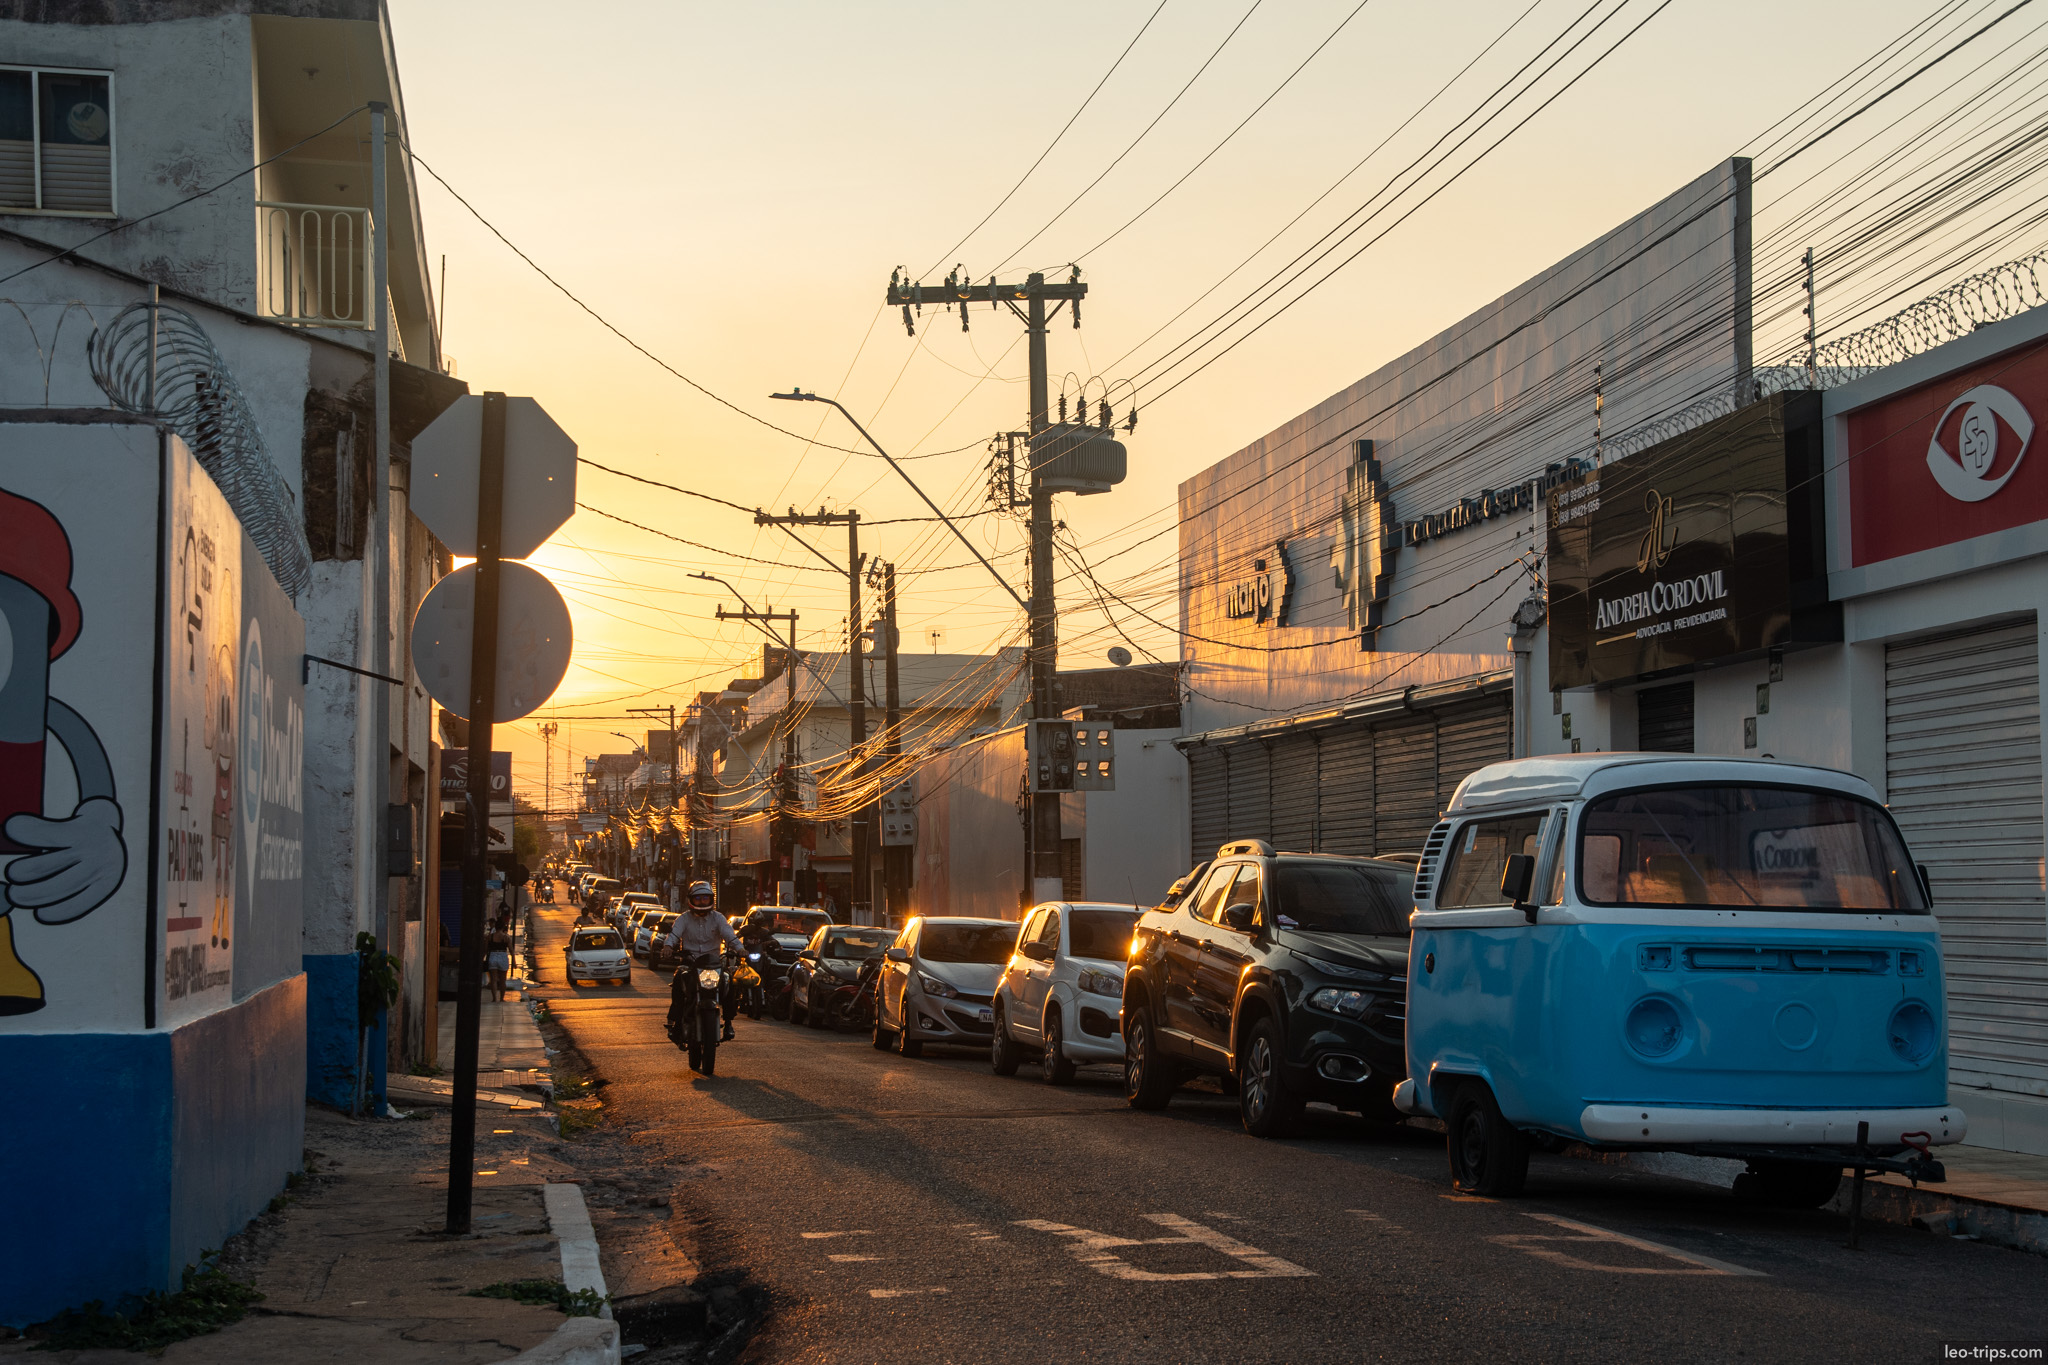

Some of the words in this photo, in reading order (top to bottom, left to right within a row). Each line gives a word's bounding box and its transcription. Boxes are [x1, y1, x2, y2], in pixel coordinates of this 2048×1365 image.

[1595, 591, 1652, 630] ANDREIA
[1651, 570, 1728, 614] CORDOVIL
[1635, 621, 1672, 639] ADVOCACIA
[1673, 608, 1728, 630] PREVIDENCIARIA
